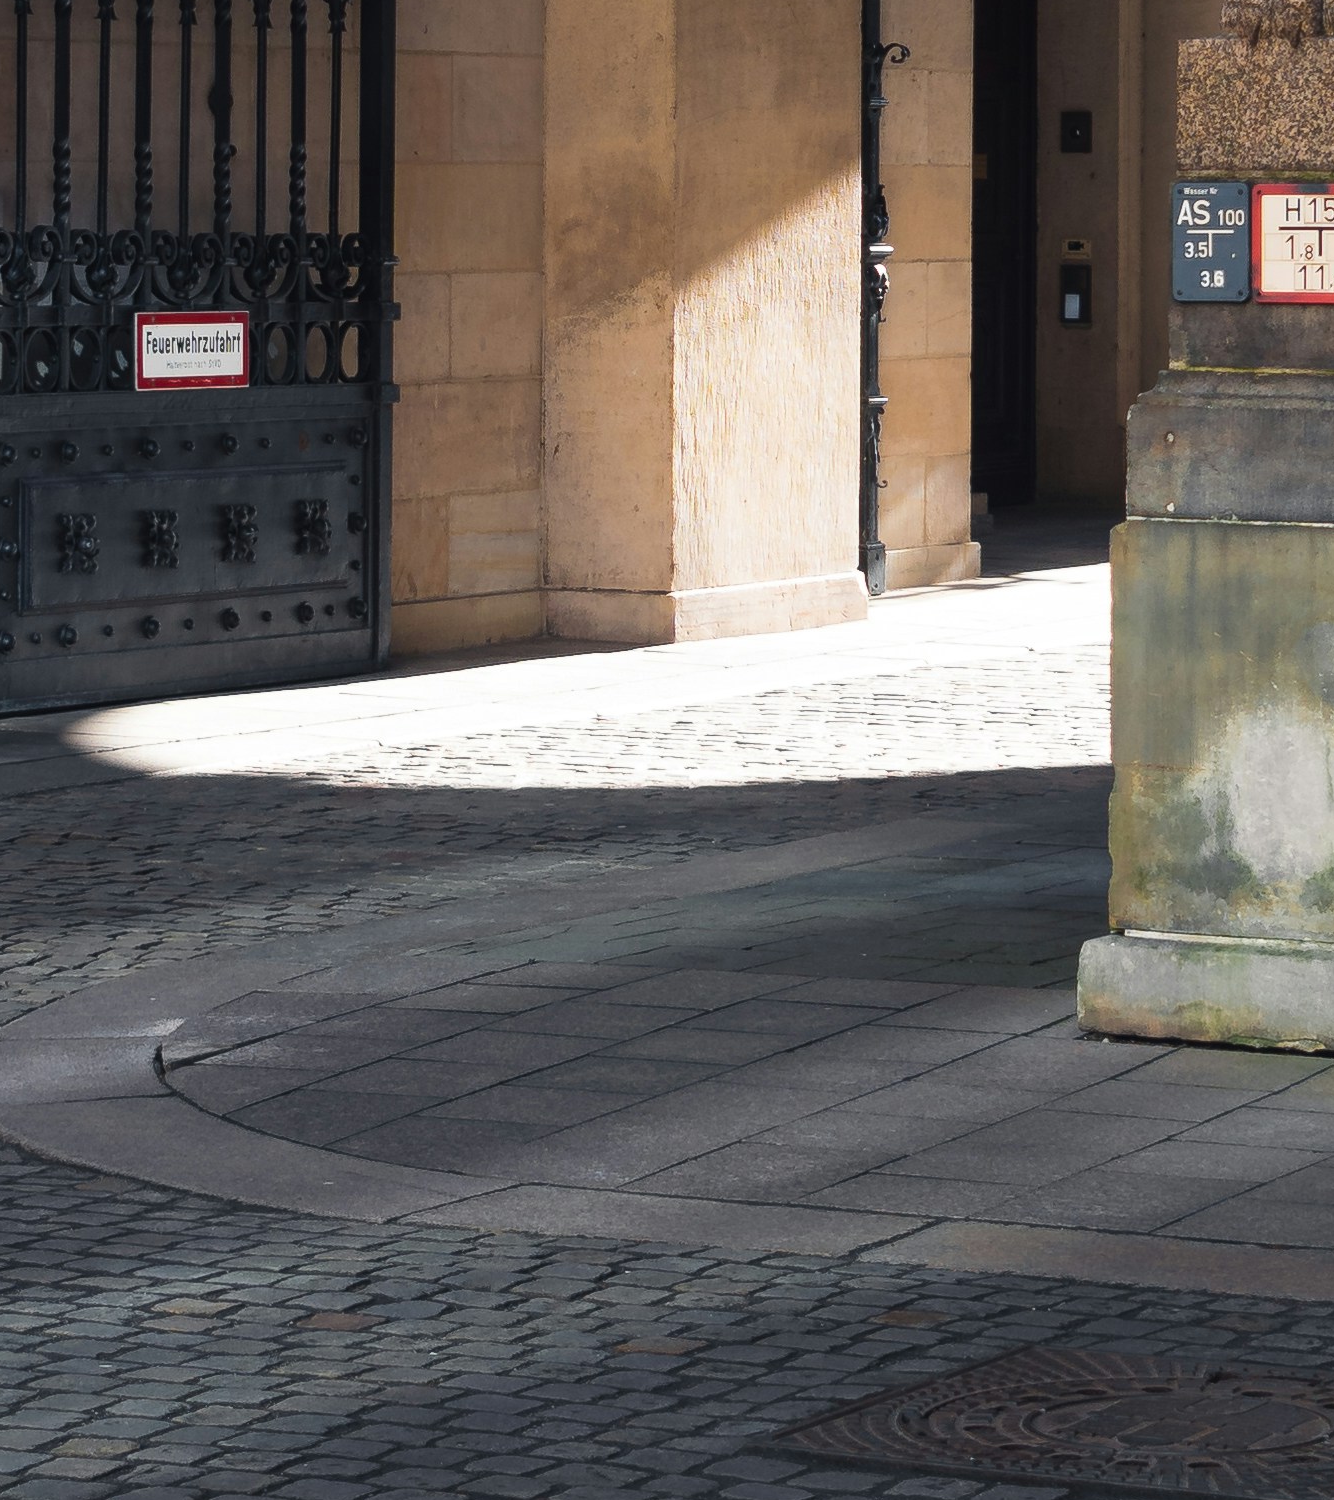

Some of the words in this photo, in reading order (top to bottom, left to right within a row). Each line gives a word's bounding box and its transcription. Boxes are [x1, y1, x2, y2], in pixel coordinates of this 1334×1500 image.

[1183, 187, 1209, 195] Wasser
[1177, 199, 1211, 226] AS
[1217, 209, 1245, 226] 100
[1285, 235, 1314, 260] 1,8
[146, 330, 241, 355] Feuerwehrzufahrt
